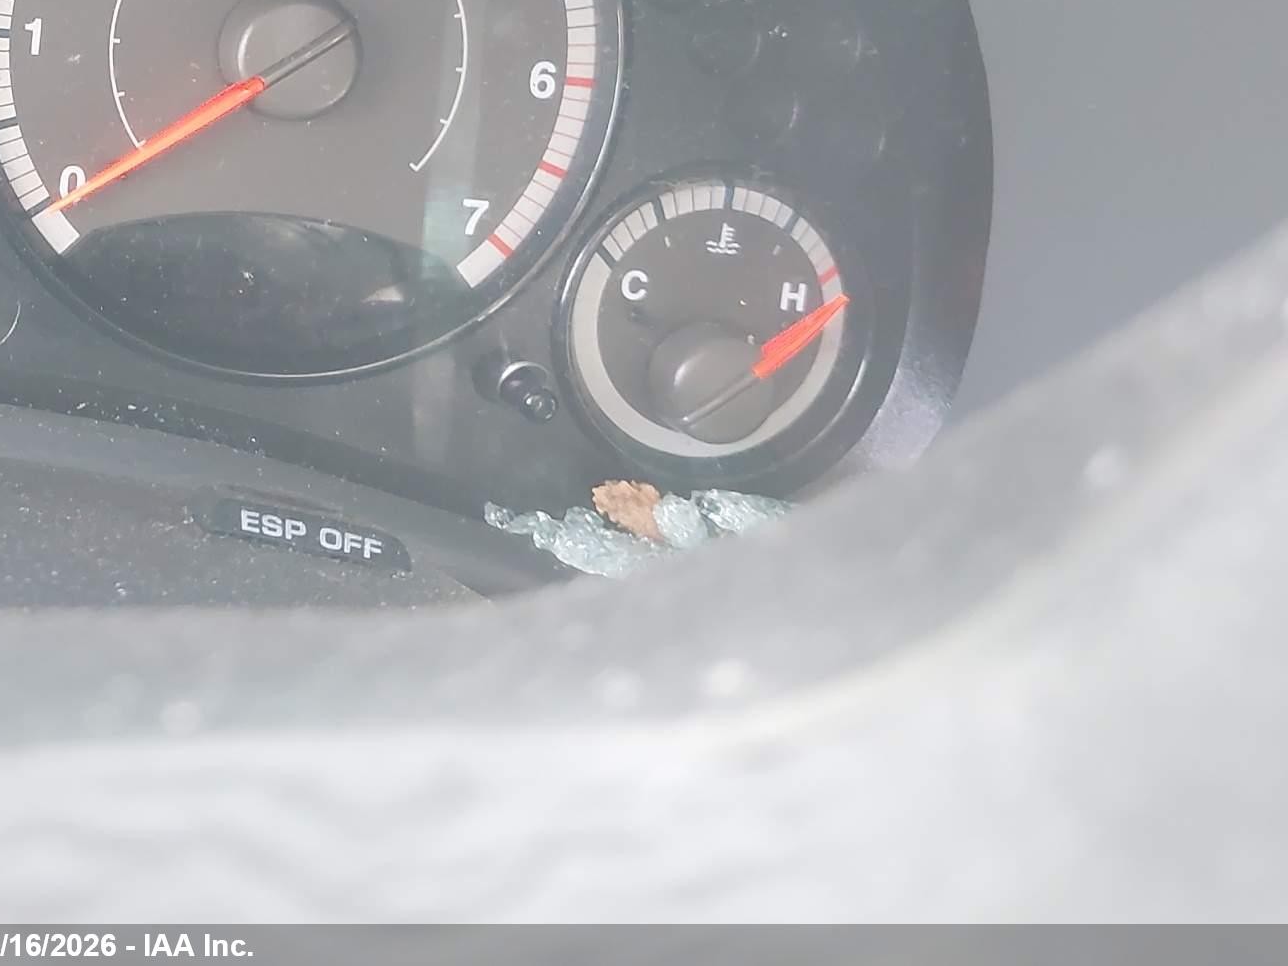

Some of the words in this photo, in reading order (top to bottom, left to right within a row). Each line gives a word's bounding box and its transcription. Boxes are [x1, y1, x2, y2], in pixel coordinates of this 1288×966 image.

[24, 17, 42, 56] 1
[529, 61, 557, 99] 6
[462, 198, 490, 236] 7
[621, 270, 648, 301] C
[780, 281, 807, 312] H
[240, 509, 307, 540] ESP
[319, 527, 382, 559] OFF
